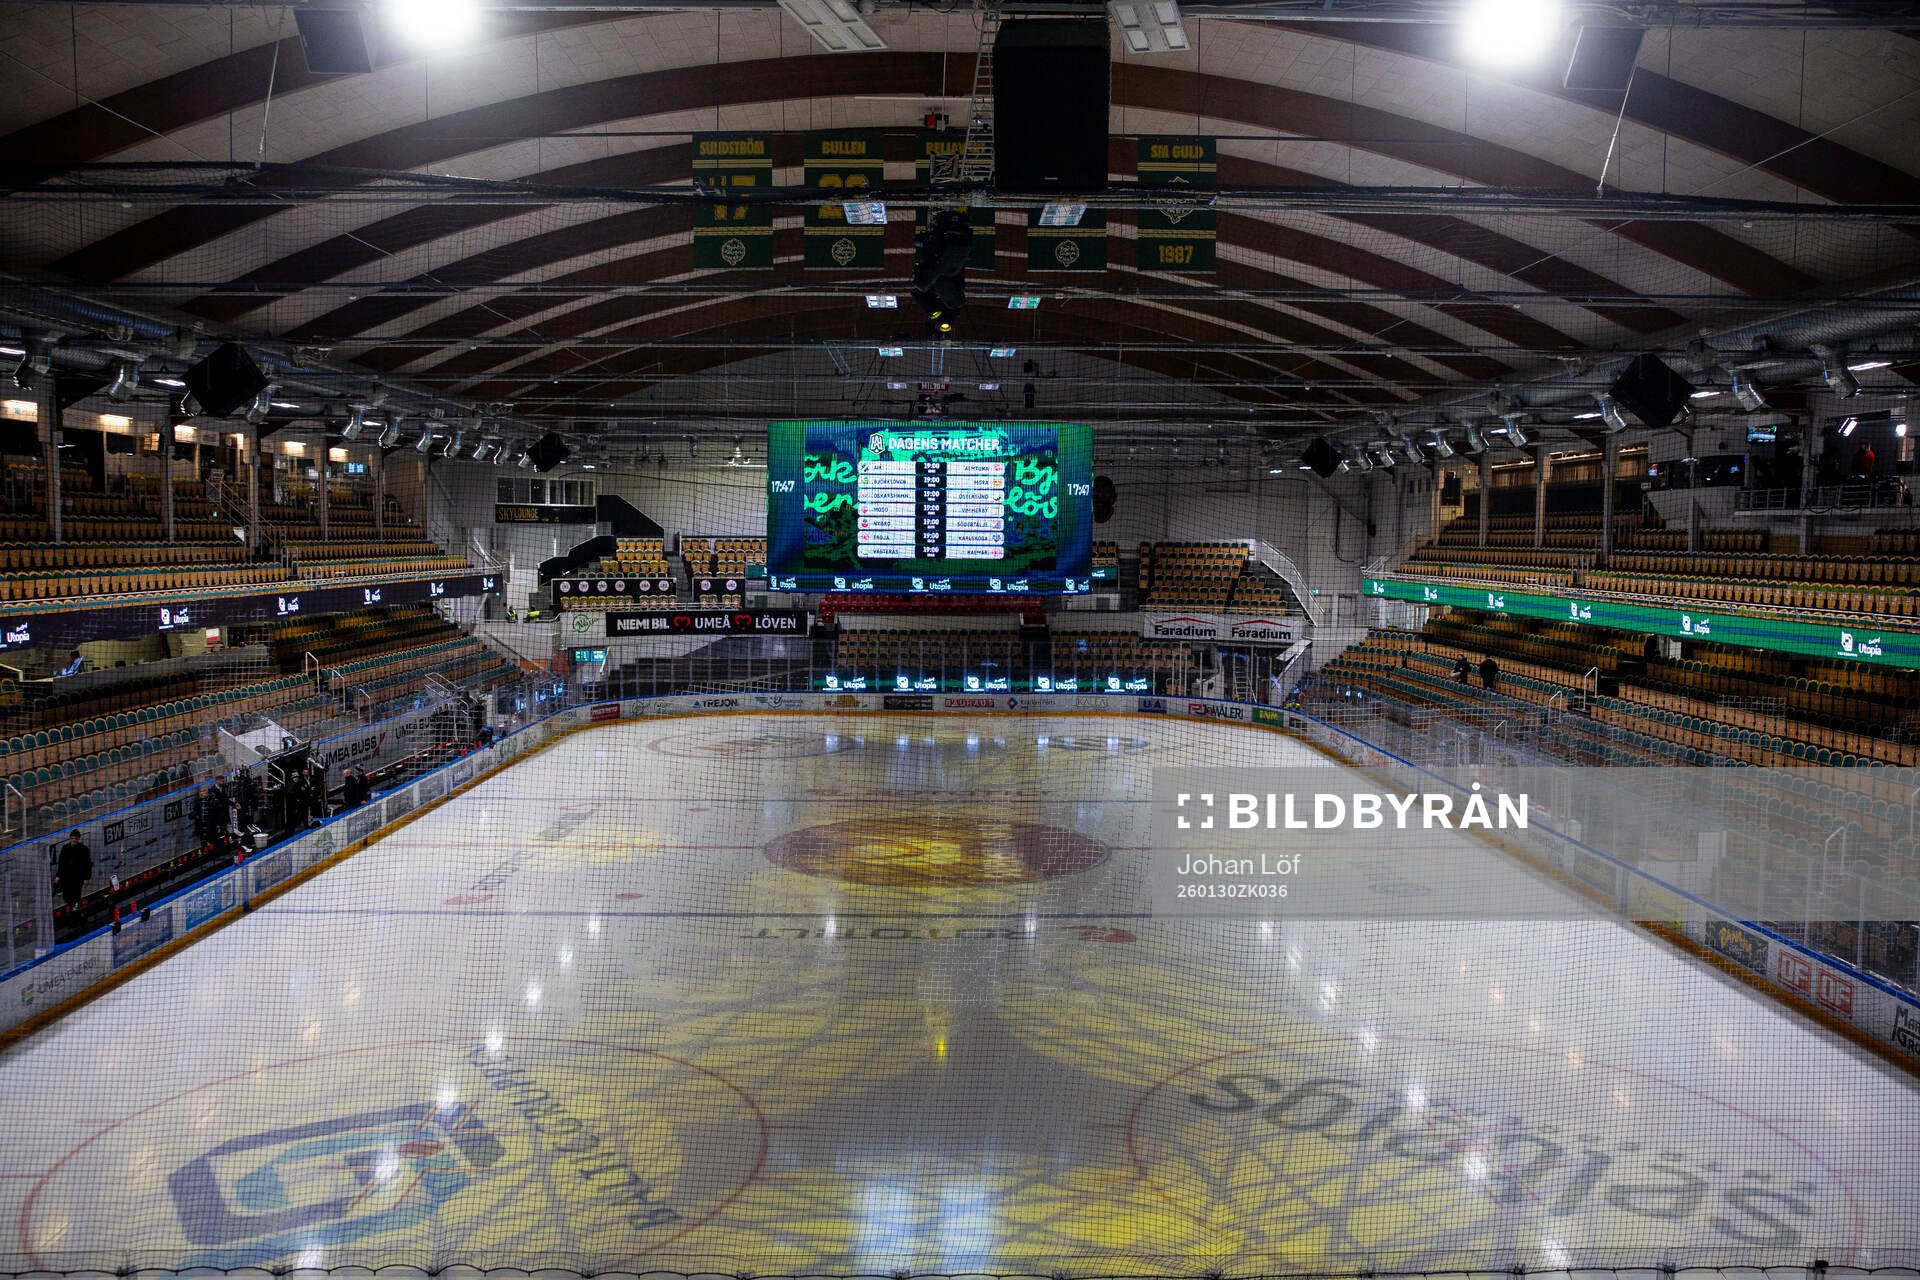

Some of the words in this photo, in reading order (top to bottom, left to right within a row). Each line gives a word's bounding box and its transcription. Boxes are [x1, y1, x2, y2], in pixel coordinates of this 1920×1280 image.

[699, 136, 766, 156] SUNDSTRÖM
[821, 140, 867, 155] BULLEN
[1171, 144, 1204, 159] GULD
[1158, 244, 1195, 265] 1987
[888, 437, 938, 450] DAGENS
[941, 438, 1000, 451] MATCHER
[771, 480, 795, 493] 17:47
[1067, 483, 1090, 496] 17:47
[852, 582, 874, 590] Utopia
[930, 582, 950, 591] Utopia
[1007, 582, 1028, 592] Utopia
[174, 613, 190, 625] Utopia
[616, 618, 650, 630] NIEMI
[652, 618, 670, 630] BIL
[694, 614, 732, 629] UMEÅ
[755, 614, 796, 629] LÖVEN
[1154, 625, 1217, 636] Faradium
[1231, 627, 1292, 640] Faradium
[1694, 622, 1710, 636] Utopia
[6, 632, 30, 646] Utopia
[1858, 642, 1882, 657] Utopia
[844, 680, 866, 690] Utopia
[914, 680, 936, 690] Utopia
[986, 680, 1007, 691] Utopia
[1056, 680, 1078, 691] Utopia
[1126, 682, 1148, 692] Utopia
[702, 698, 738, 708] TREJON
[944, 698, 994, 708] BAUHAUS
[351, 736, 377, 756] BUSS
[166, 803, 181, 820] BW
[106, 825, 123, 843] BW
